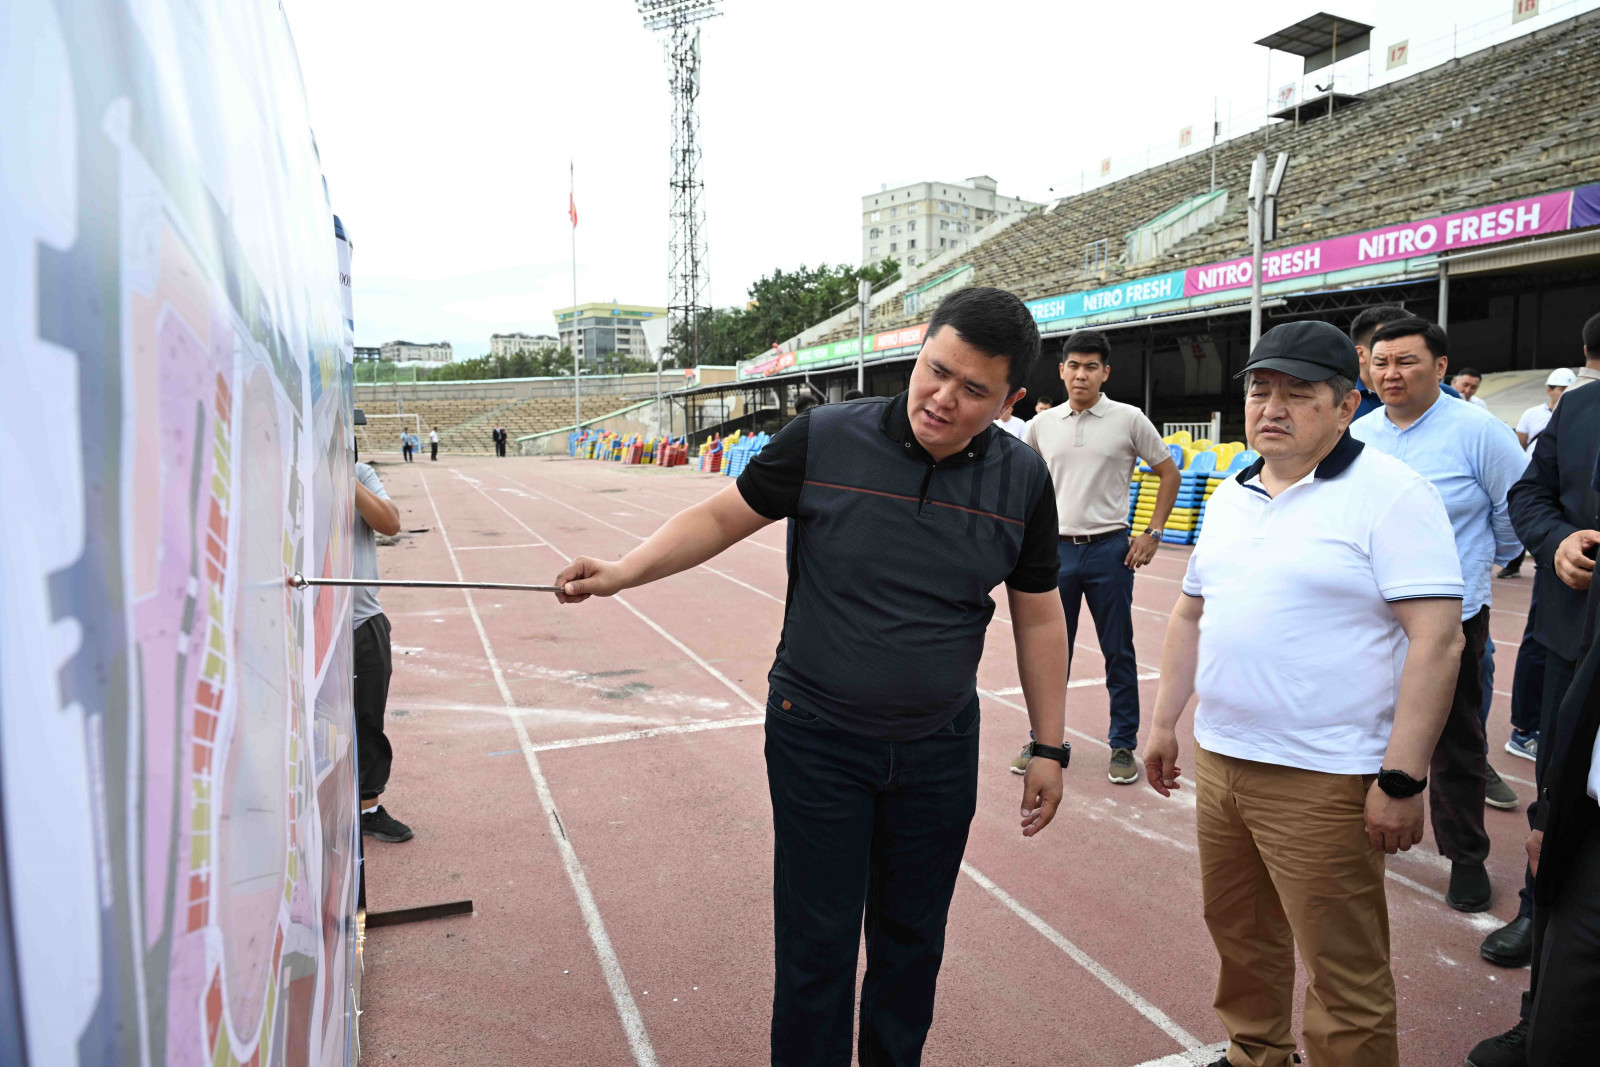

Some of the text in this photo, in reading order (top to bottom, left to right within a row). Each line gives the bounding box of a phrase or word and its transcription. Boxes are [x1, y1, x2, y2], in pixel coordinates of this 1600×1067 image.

[1391, 45, 1406, 62] 17
[1358, 203, 1541, 261] NITRO FRESH
[1198, 261, 1253, 290] NITRO
[1031, 299, 1065, 319] FRESH
[1083, 278, 1172, 312] NITRO FRESH
